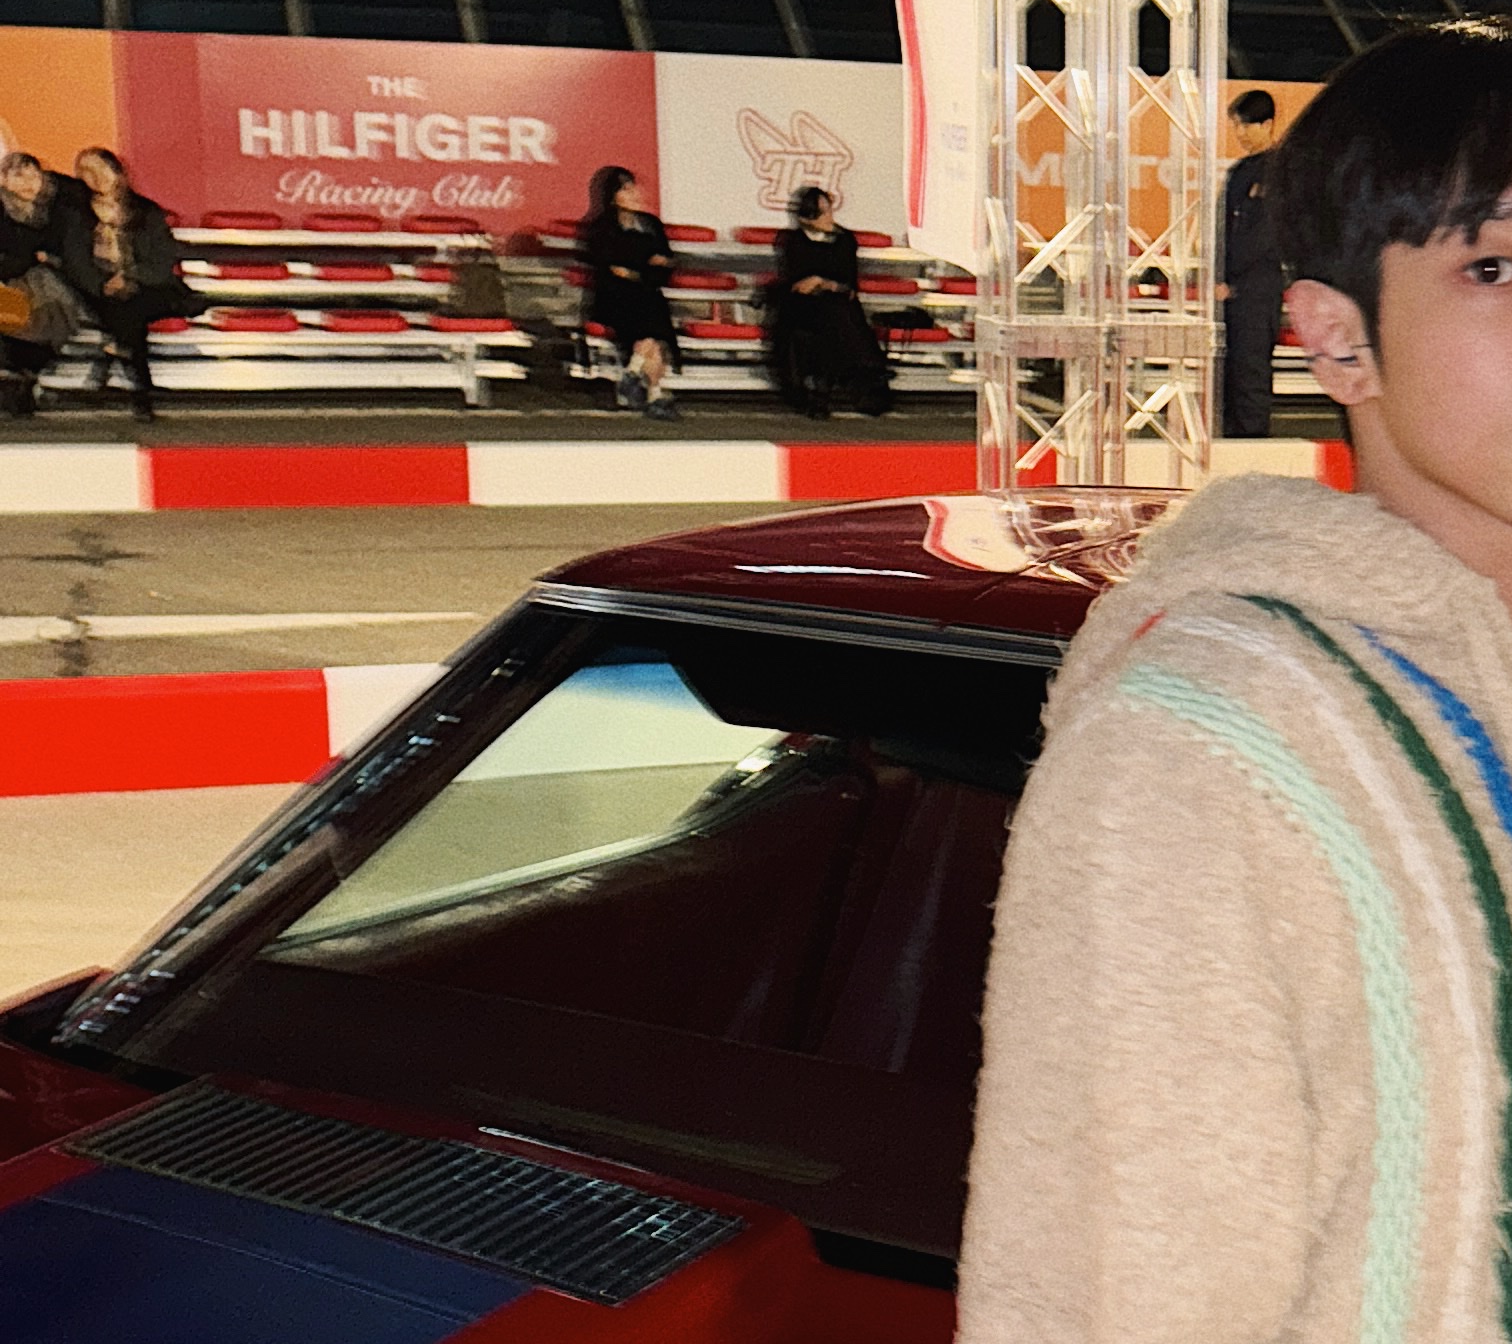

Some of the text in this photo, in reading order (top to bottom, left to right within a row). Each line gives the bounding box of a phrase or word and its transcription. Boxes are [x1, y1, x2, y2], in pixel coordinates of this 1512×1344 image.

[367, 74, 426, 98] THE
[238, 107, 557, 164] HILFIGER
[275, 169, 524, 217] Racing Club
